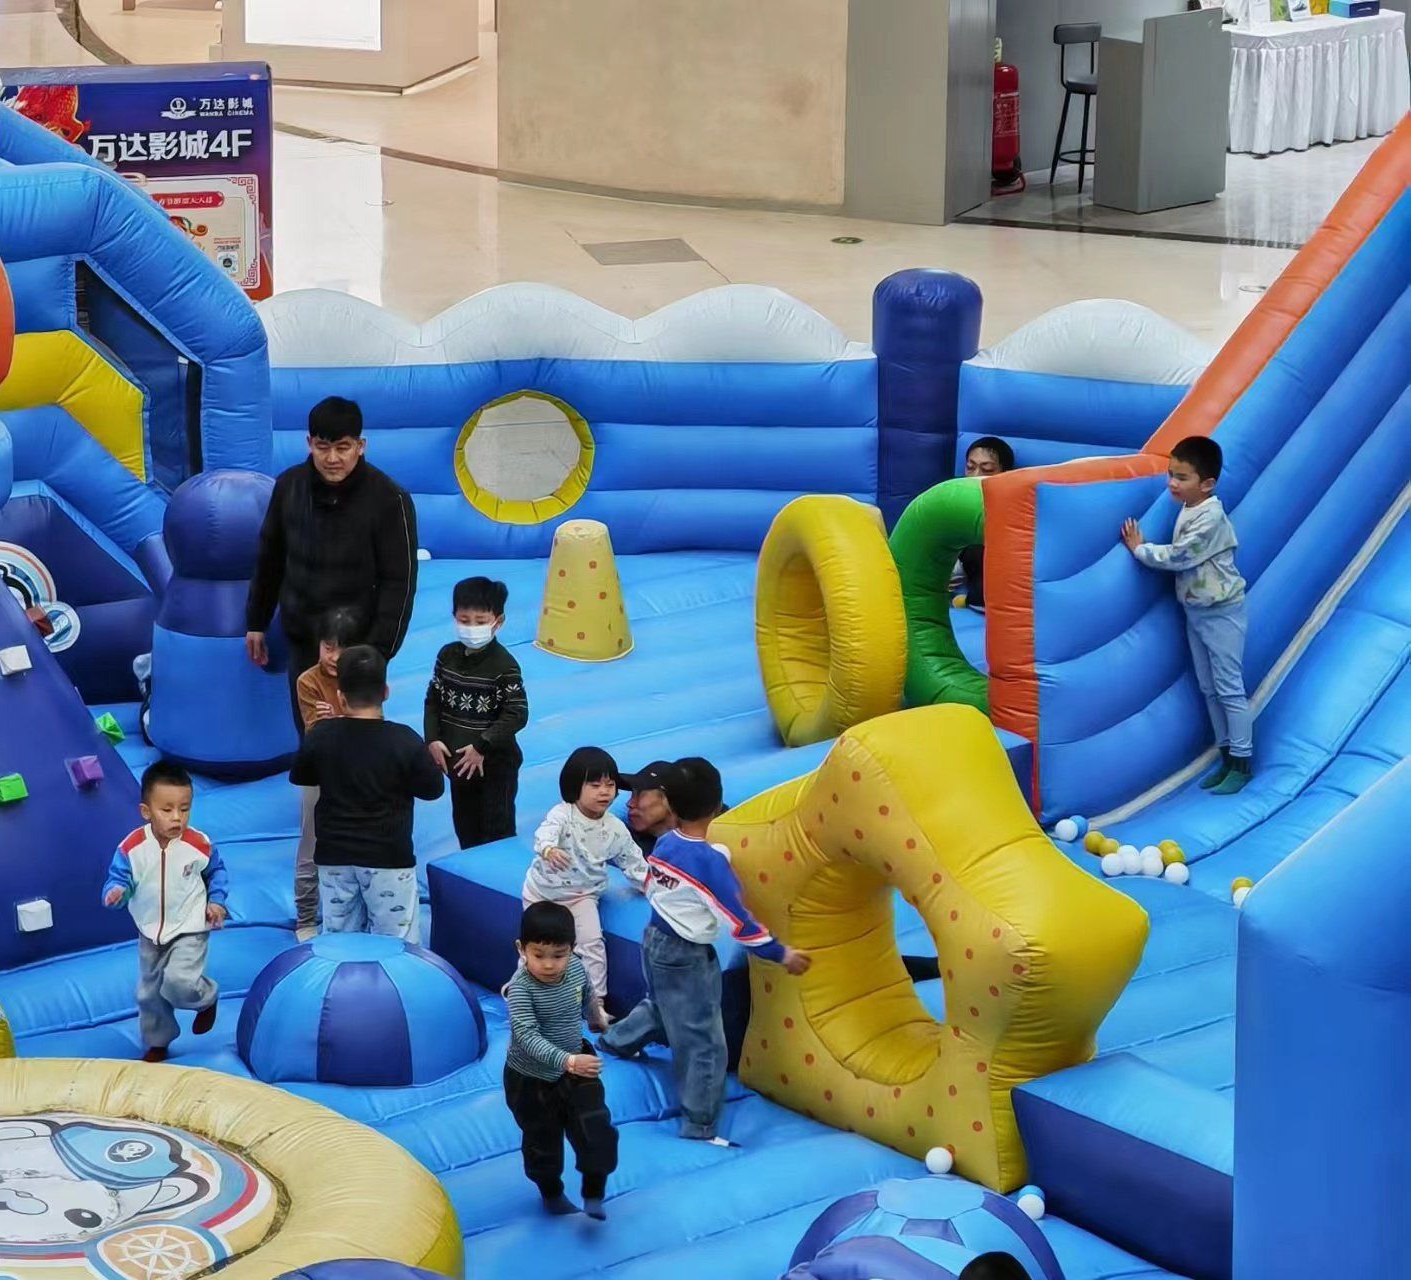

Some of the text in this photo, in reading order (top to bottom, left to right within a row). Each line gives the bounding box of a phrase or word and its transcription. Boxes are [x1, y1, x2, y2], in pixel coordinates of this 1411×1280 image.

[199, 97, 254, 110] 万达影城
[87, 129, 253, 163] 万达影城4F
